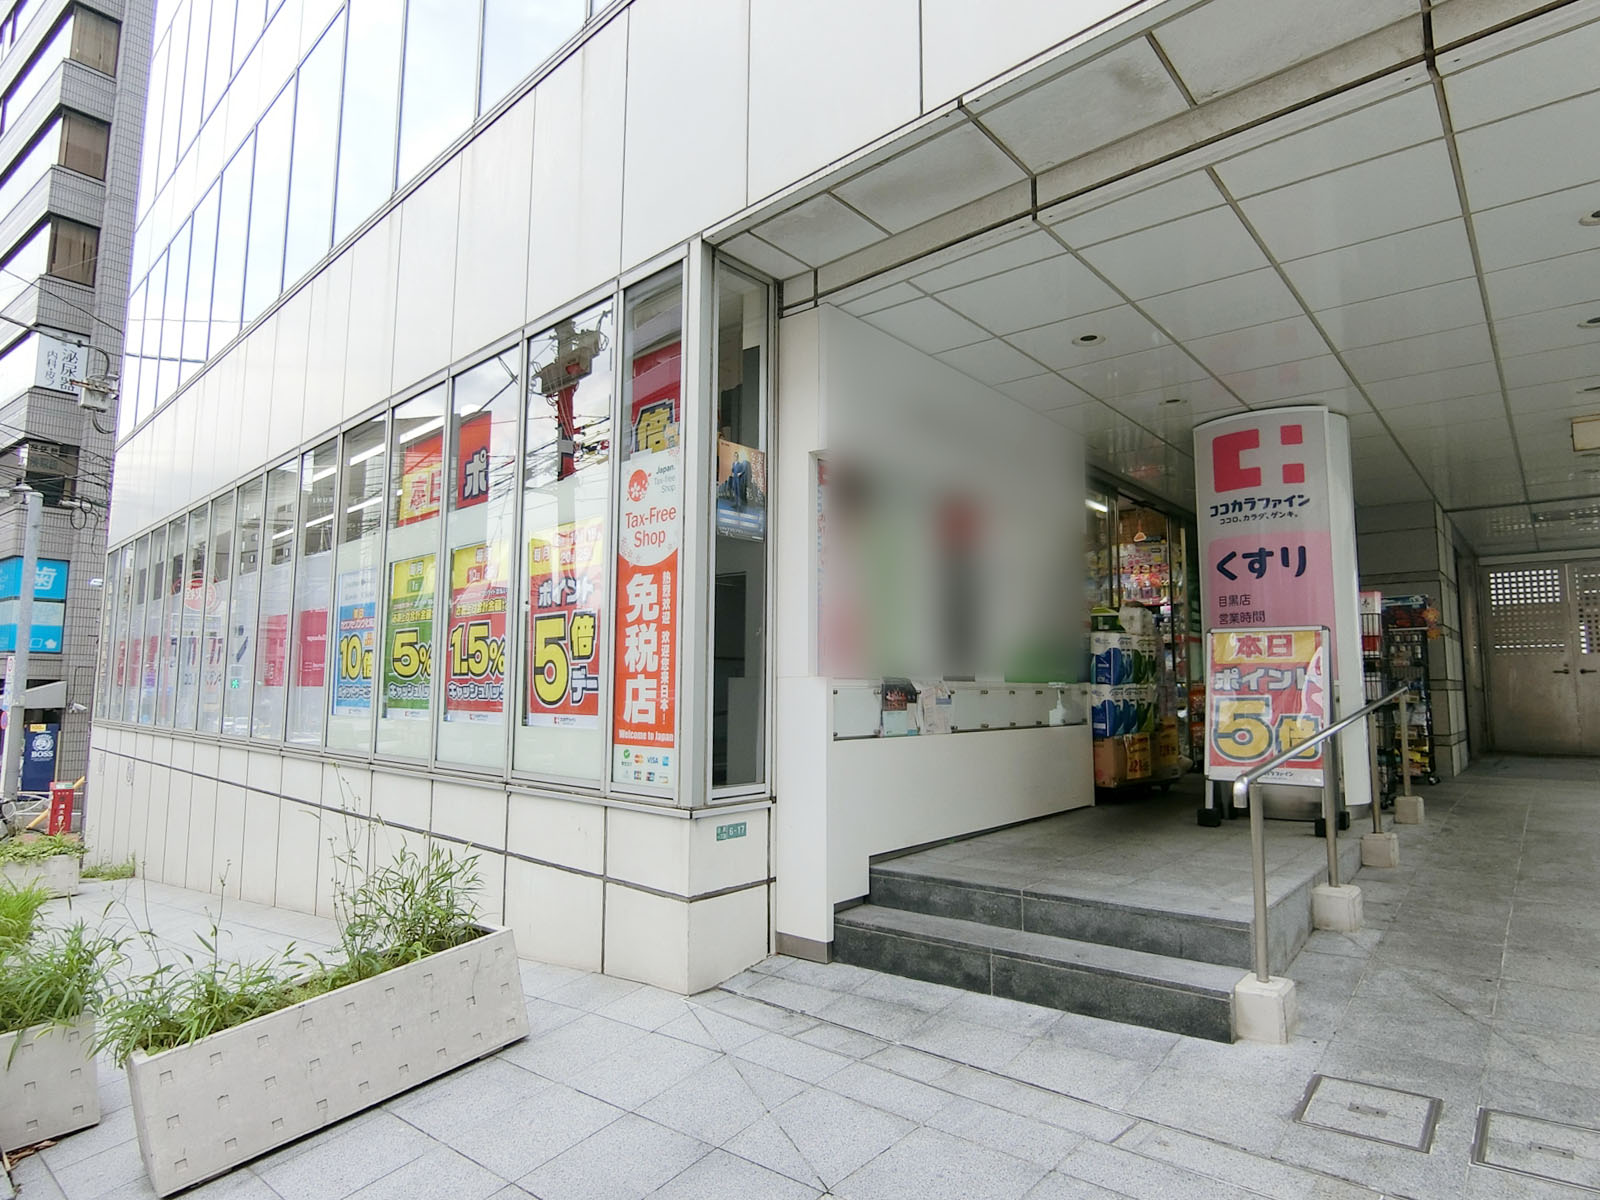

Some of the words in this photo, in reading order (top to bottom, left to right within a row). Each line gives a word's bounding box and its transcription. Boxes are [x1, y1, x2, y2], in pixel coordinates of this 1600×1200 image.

[625, 506, 677, 529] Tax-Free
[1210, 494, 1310, 518] ココカラファイン
[633, 519, 666, 548] Shop
[1216, 545, 1307, 581] くすり
[537, 575, 594, 608] ポイント
[1219, 594, 1251, 607] 目黒店
[1219, 610, 1265, 625] 営業時間
[623, 573, 659, 724] 免税店
[1234, 634, 1293, 658] 本日
[1213, 695, 1323, 762] 5倍
[31, 750, 54, 758] BOSS
